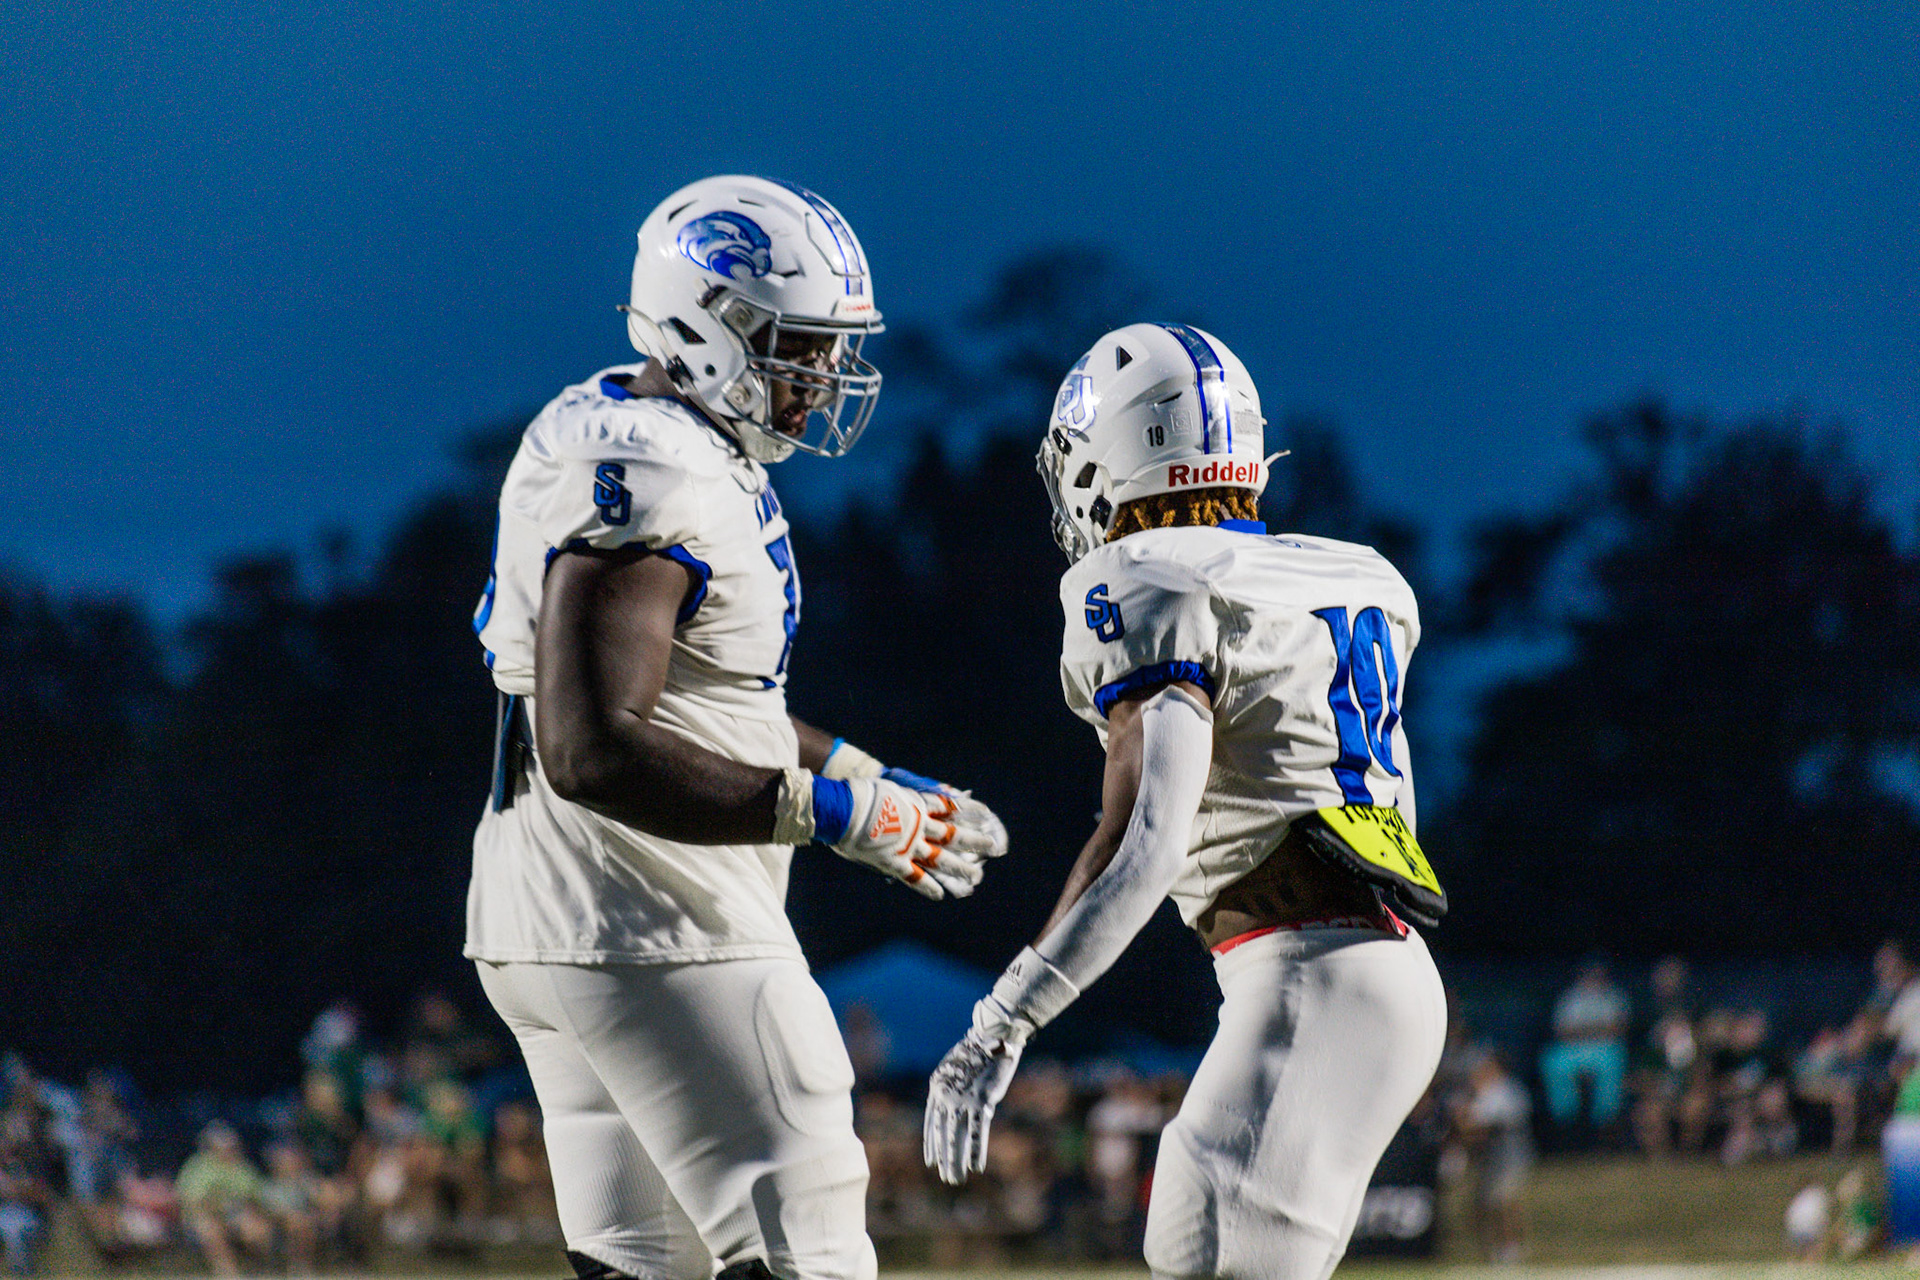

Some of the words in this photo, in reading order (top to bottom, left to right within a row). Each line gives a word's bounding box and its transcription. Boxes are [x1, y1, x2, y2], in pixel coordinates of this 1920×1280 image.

[1147, 425, 1165, 447] 19
[1168, 461, 1258, 487] Riddell
[1311, 606, 1404, 806] 10
